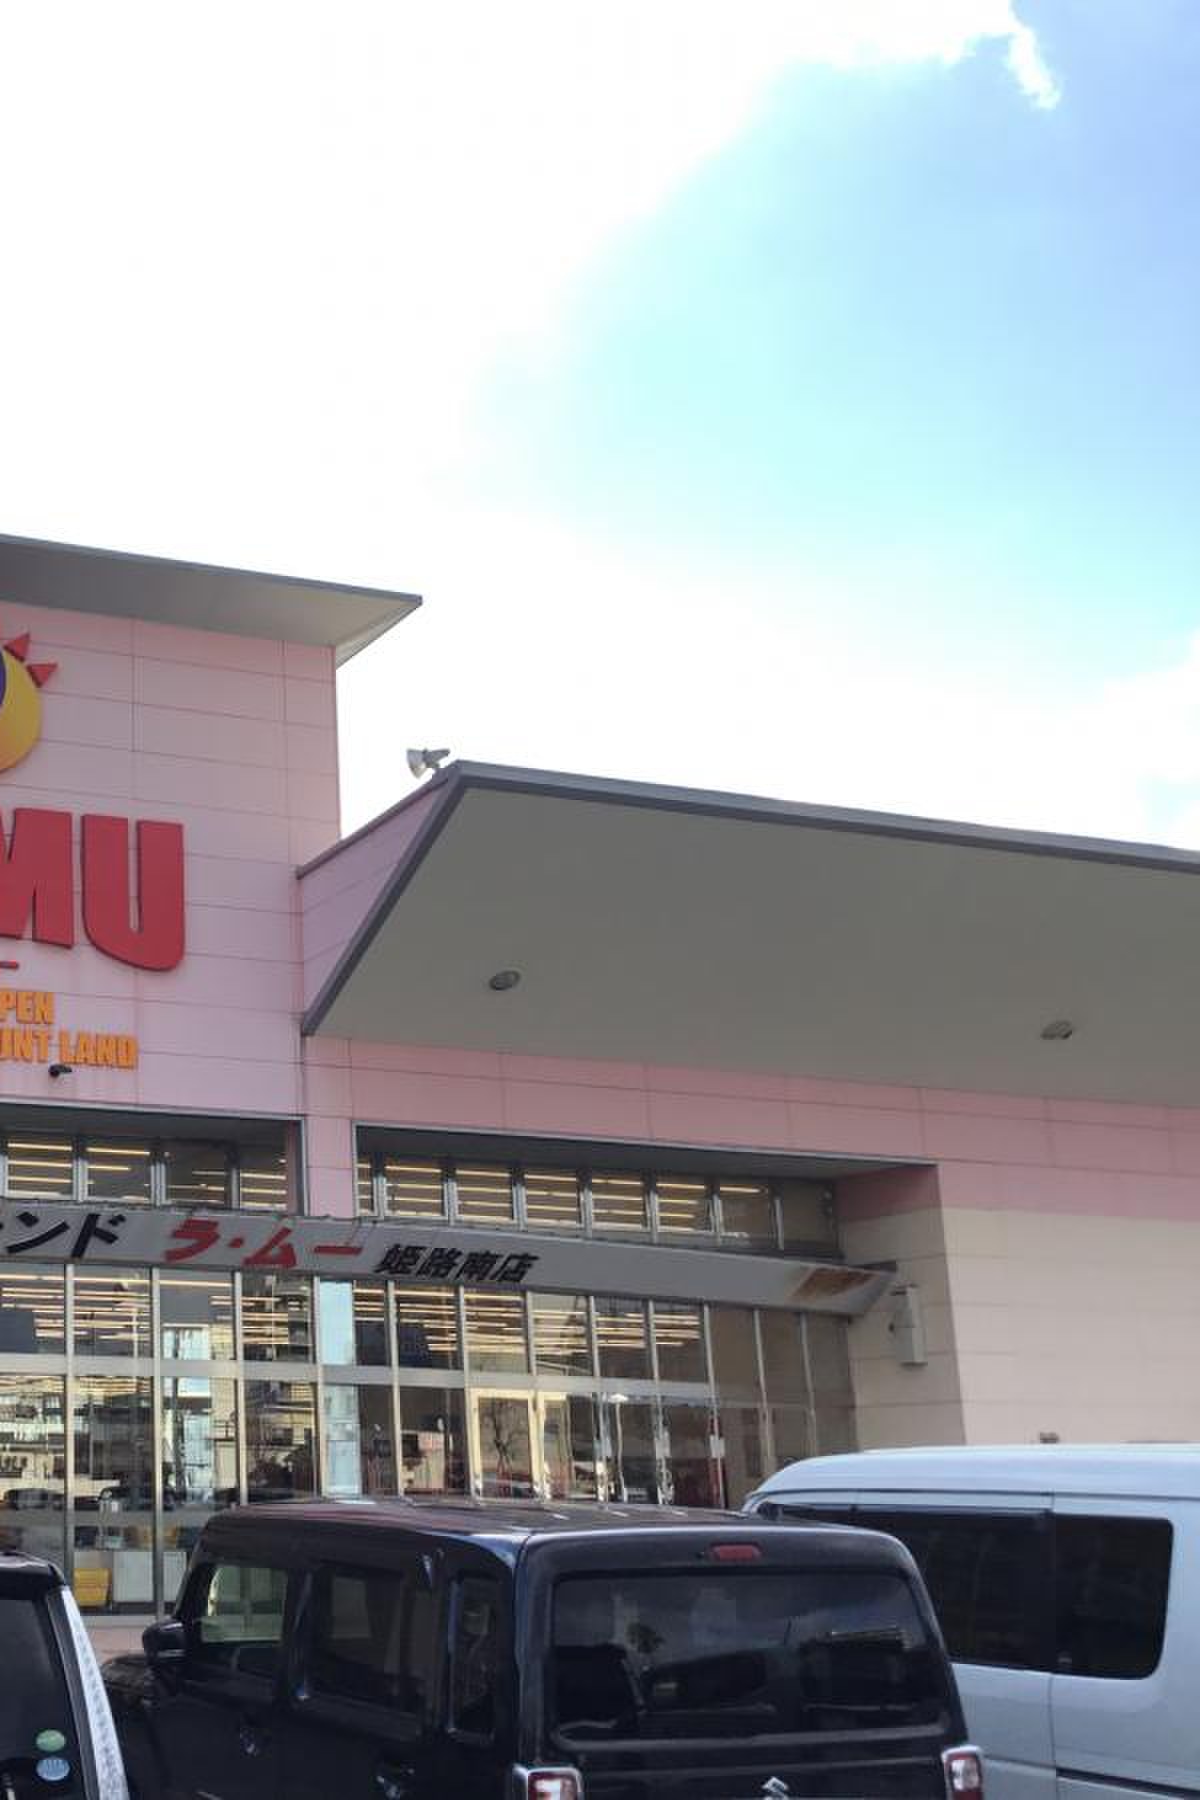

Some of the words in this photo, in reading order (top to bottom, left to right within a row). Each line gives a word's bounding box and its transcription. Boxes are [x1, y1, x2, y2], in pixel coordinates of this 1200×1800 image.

[58, 1030, 138, 1069] LAND
[373, 1242, 539, 1283] 姫路南店
